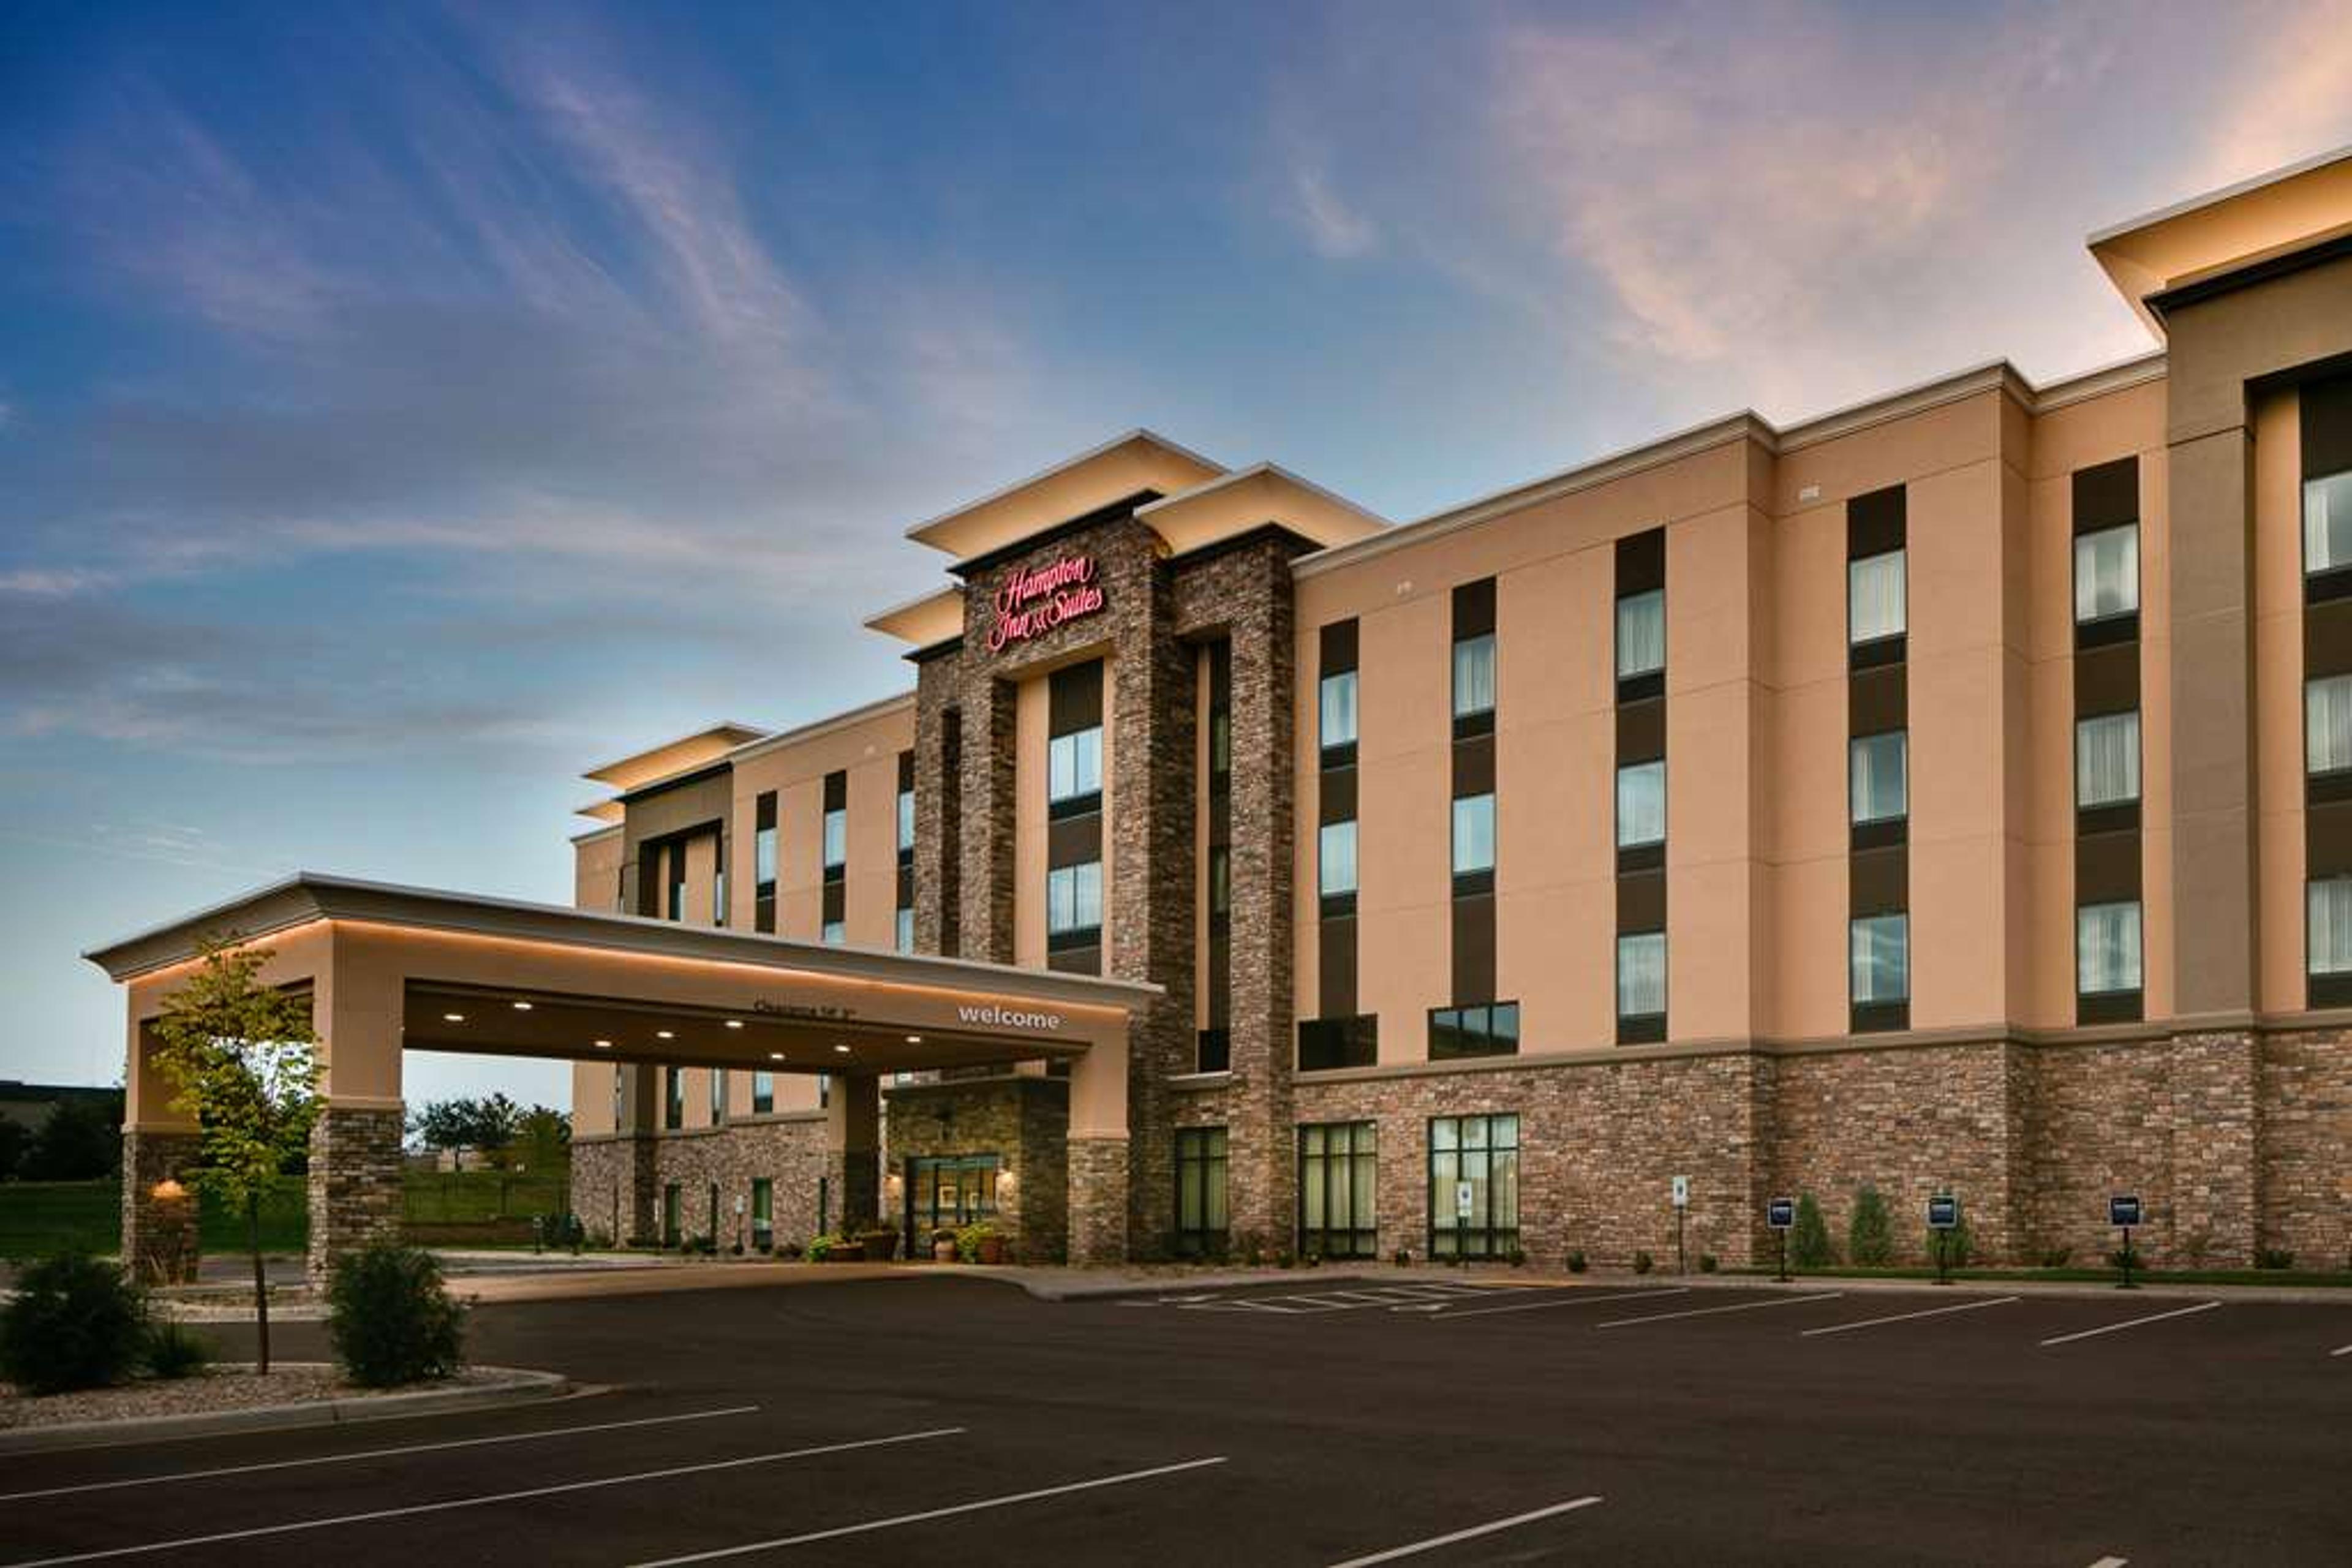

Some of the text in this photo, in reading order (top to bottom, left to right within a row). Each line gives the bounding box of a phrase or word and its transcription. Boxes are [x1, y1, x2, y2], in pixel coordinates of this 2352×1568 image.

[994, 557, 1093, 614] Hampton
[988, 612, 1035, 651] Inn
[1047, 586, 1102, 624] Suites
[957, 1005, 1060, 1029] welcome
